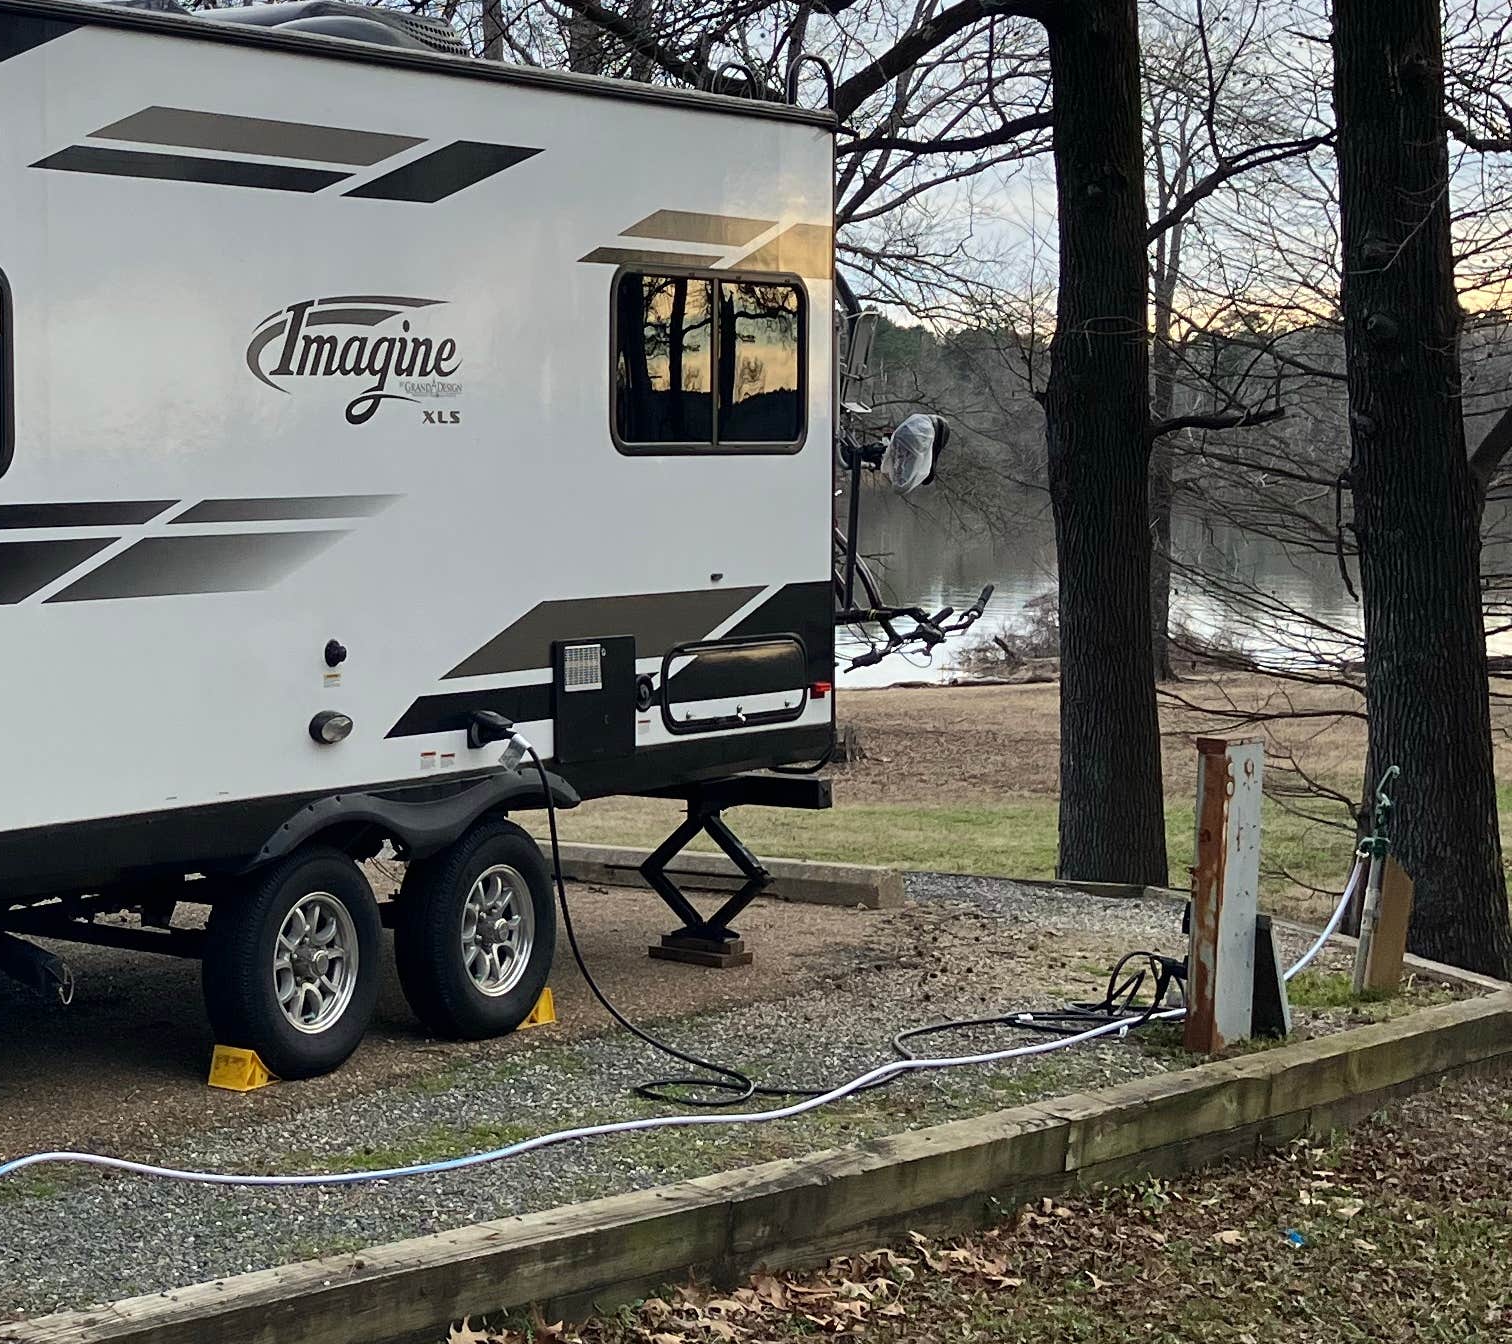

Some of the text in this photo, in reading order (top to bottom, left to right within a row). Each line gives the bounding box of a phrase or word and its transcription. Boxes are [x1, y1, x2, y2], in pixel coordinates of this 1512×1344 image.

[269, 299, 463, 425] Imagine
[404, 381, 433, 394] GRAND
[437, 381, 463, 394] DESIGN
[422, 410, 460, 424] XLS
